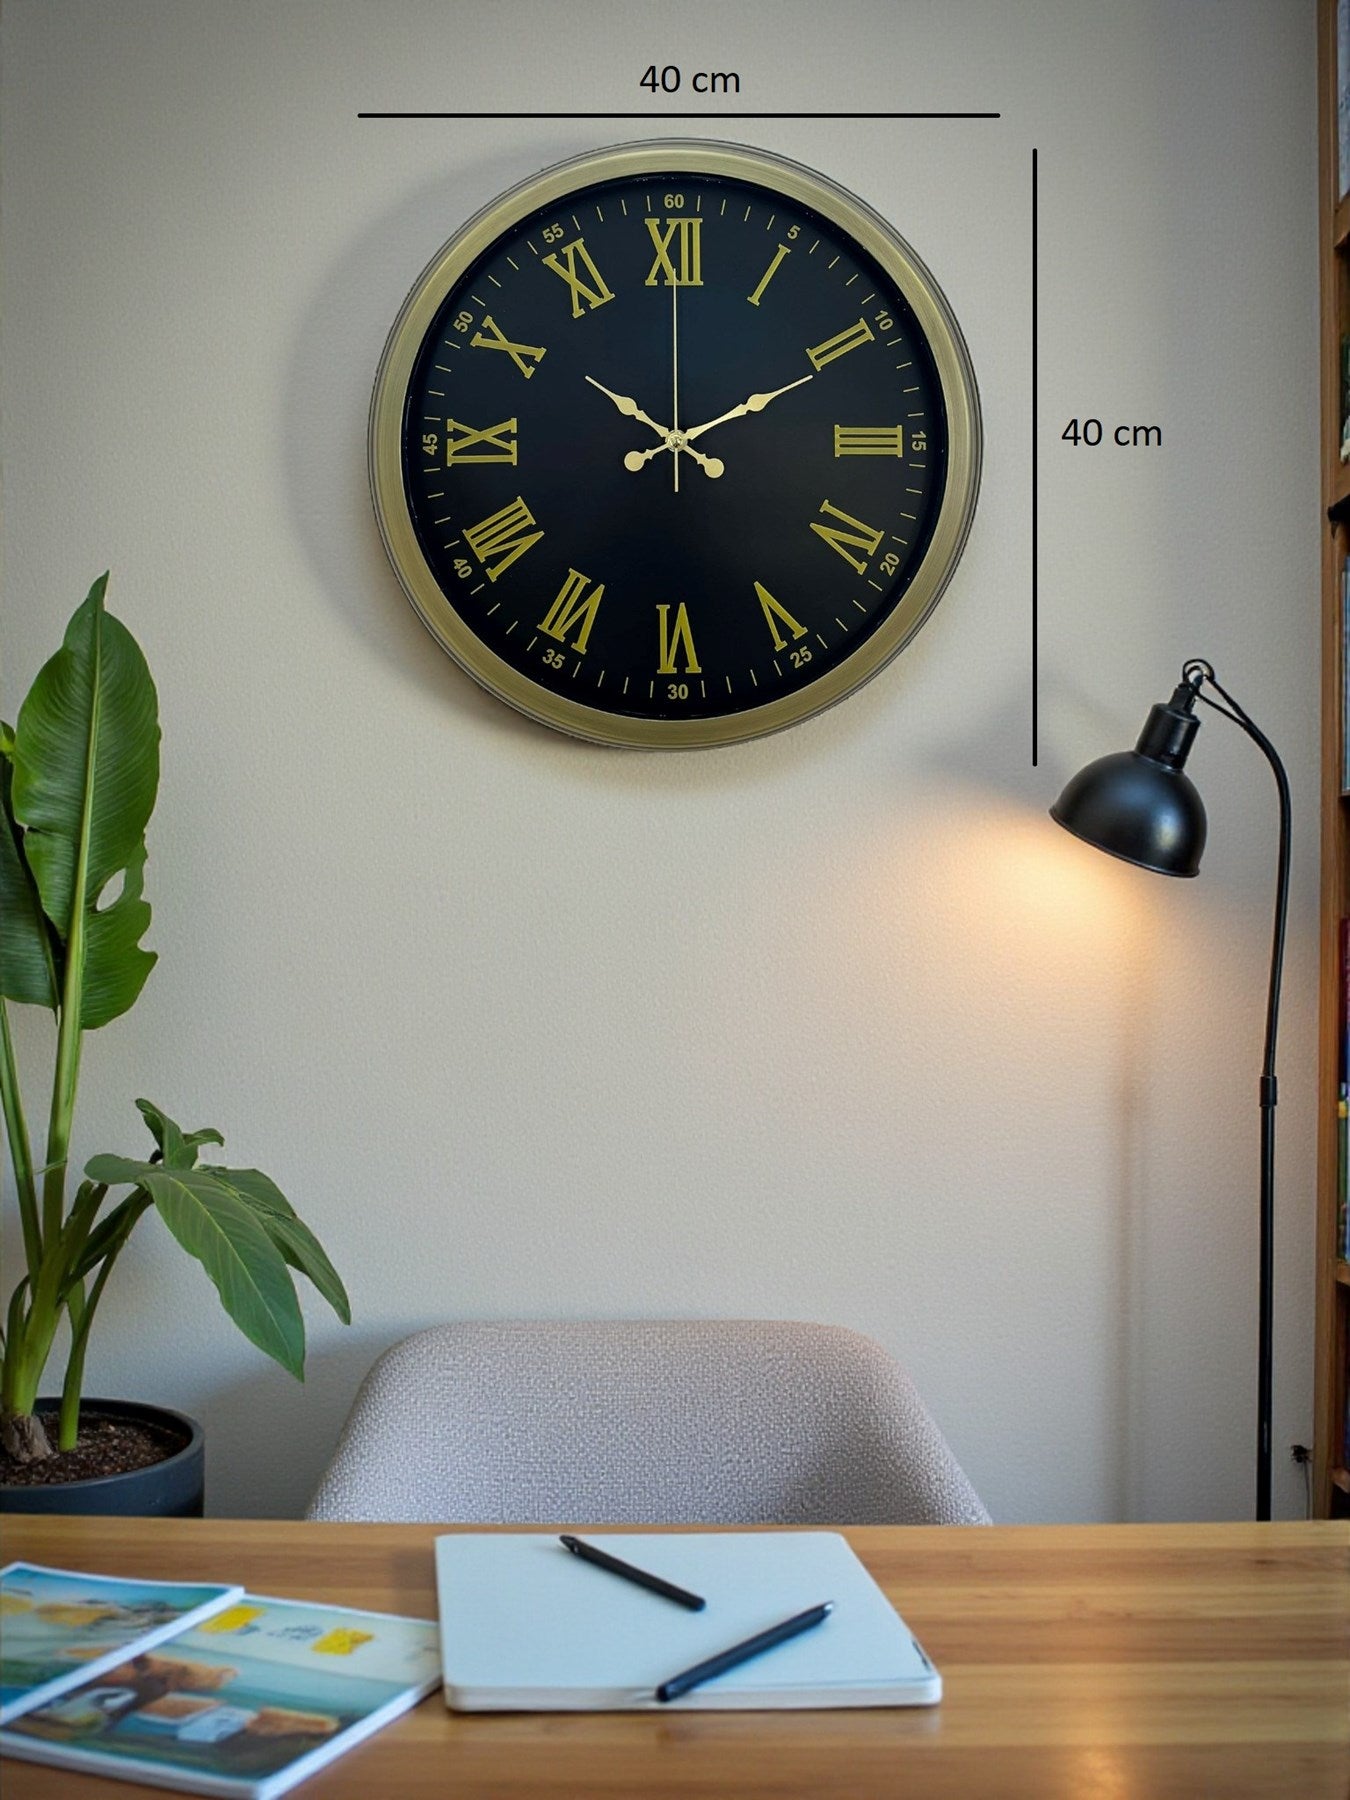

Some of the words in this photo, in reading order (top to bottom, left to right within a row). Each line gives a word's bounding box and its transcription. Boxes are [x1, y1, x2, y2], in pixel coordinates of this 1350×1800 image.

[664, 194, 685, 208] 60
[543, 223, 565, 244] 55
[787, 225, 801, 240] 5
[645, 218, 703, 286] XII
[542, 238, 615, 318] XI
[747, 243, 791, 306] I
[453, 311, 474, 333] 50
[875, 310, 894, 331] 10
[470, 315, 547, 379] X
[806, 318, 875, 372] II
[422, 434, 437, 456] 45
[447, 418, 517, 467] IX
[834, 424, 903, 457] III
[912, 431, 927, 451] 15
[462, 496, 544, 582] VIII
[810, 499, 885, 575] IV
[454, 558, 473, 579] 40
[880, 553, 900, 577] 20
[537, 568, 605, 654] VII
[754, 581, 808, 652] V
[656, 603, 701, 673] VI
[542, 648, 566, 670] 35
[790, 646, 813, 669] 25
[667, 684, 688, 699] 30
